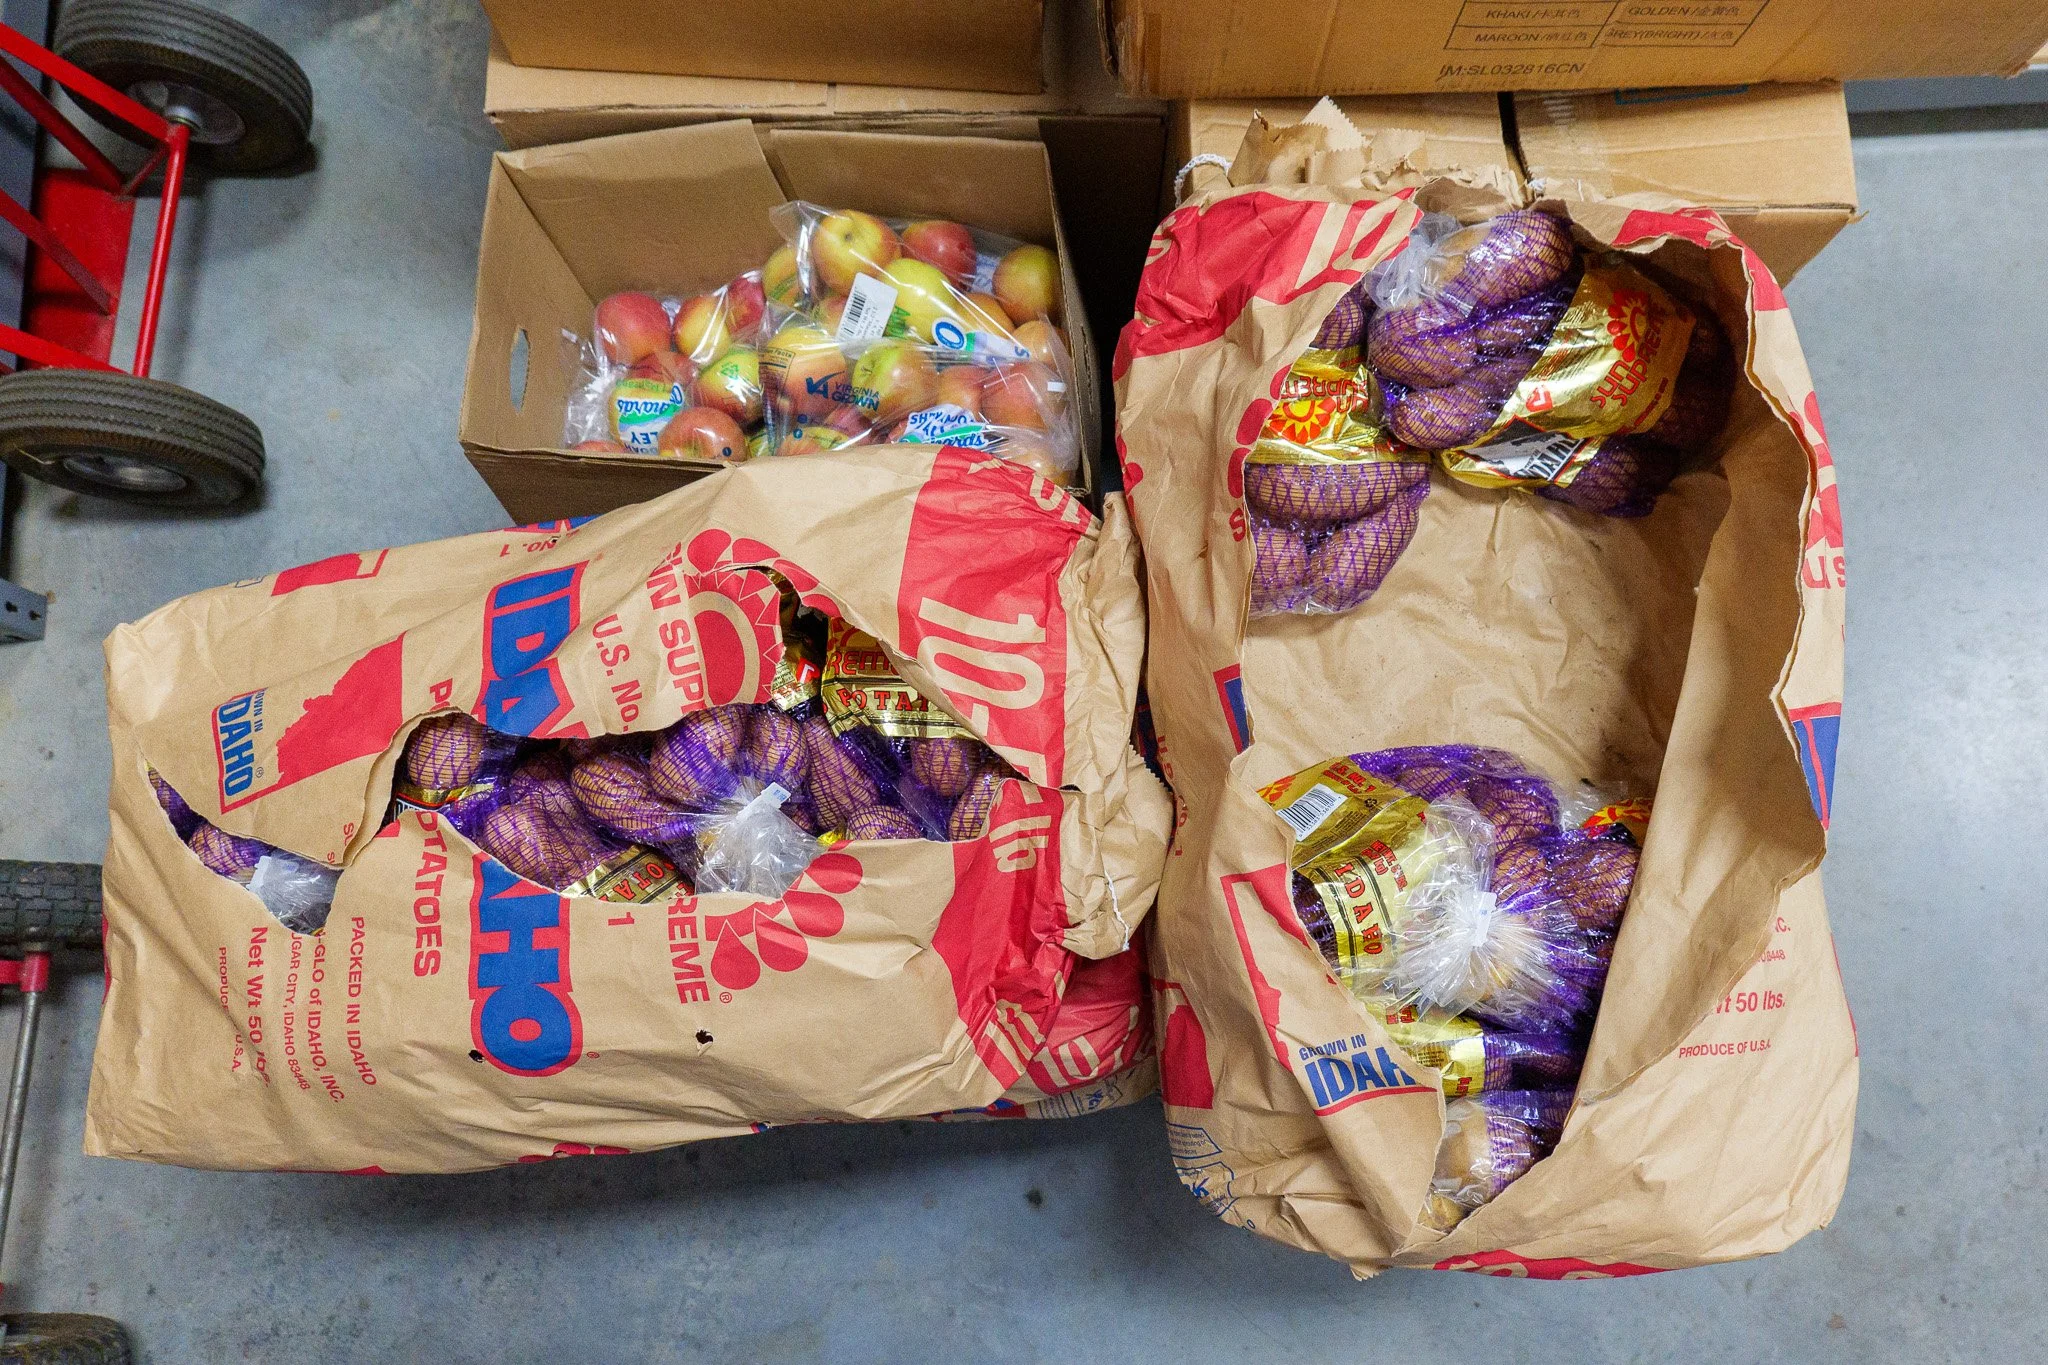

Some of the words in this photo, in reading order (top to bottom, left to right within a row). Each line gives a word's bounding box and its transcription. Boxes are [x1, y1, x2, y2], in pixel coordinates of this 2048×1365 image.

[1486, 10, 1532, 18] KHAKI
[1628, 7, 1691, 16] GOLDEN
[1475, 33, 1540, 41] MAROON
[1611, 312, 1673, 408] SUPREM
[832, 391, 880, 411] GROWN
[835, 382, 880, 398] VIRGINIA
[592, 614, 630, 676] U.S.
[612, 680, 642, 732] No.
[254, 719, 264, 732] IN
[219, 696, 254, 796] DAHO
[608, 912, 635, 926] 1
[1334, 862, 1384, 955] IDAHO
[248, 927, 268, 967] Net
[348, 917, 365, 998] PACKED
[247, 975, 263, 1007] Wt
[285, 974, 297, 1006] CITY,
[309, 988, 322, 1005] of
[1737, 992, 1758, 1012] 50
[1763, 992, 1786, 1009] lbs.
[347, 1004, 360, 1024] IN
[249, 1016, 263, 1044] 50
[284, 1012, 295, 1056] IDAHO
[307, 1010, 326, 1070] IDAHO,
[347, 1030, 376, 1085] IDAHO
[1300, 1040, 1347, 1060] GROWN
[1352, 1036, 1366, 1047] IN
[1678, 1042, 1735, 1059] PRODUCE
[1737, 1041, 1748, 1054] OF
[288, 1059, 308, 1088] 83448
[321, 1075, 344, 1098] INC.
